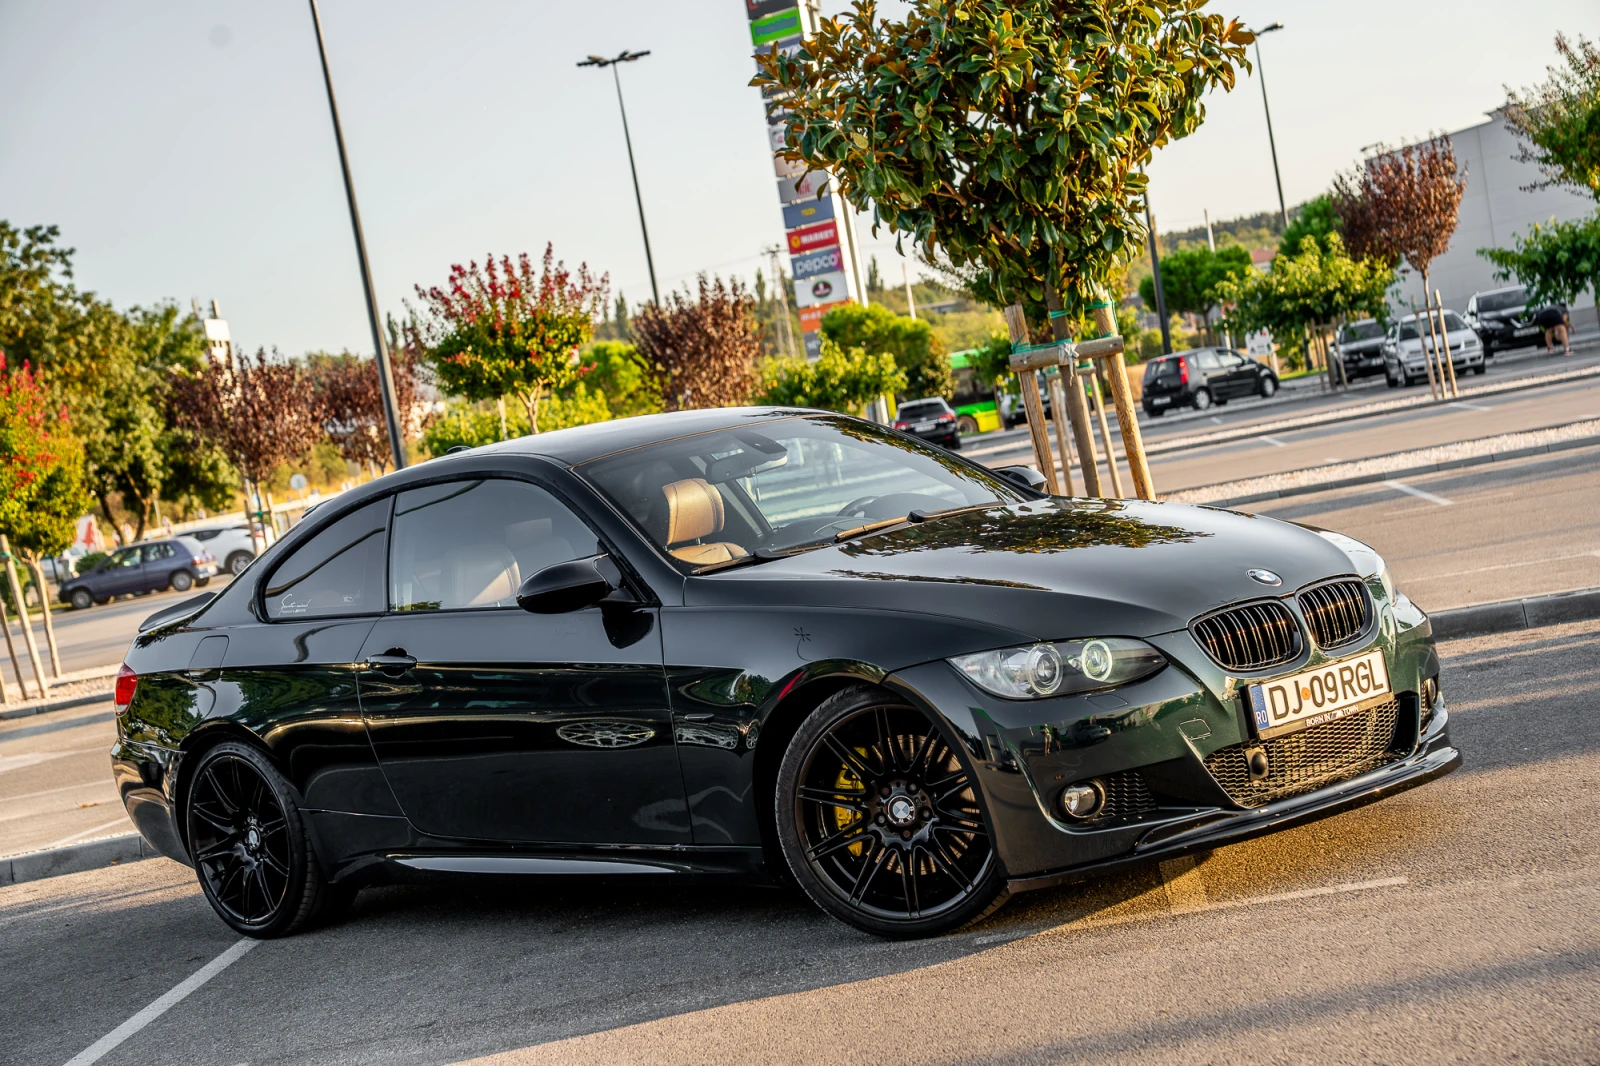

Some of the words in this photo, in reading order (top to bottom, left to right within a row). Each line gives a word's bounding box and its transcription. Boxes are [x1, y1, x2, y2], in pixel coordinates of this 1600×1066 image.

[795, 253, 838, 277] pepco
[1255, 710, 1268, 725] RO
[1306, 715, 1325, 727] BORN
[1324, 713, 1332, 722] IN
[1343, 704, 1359, 716] TOWN
